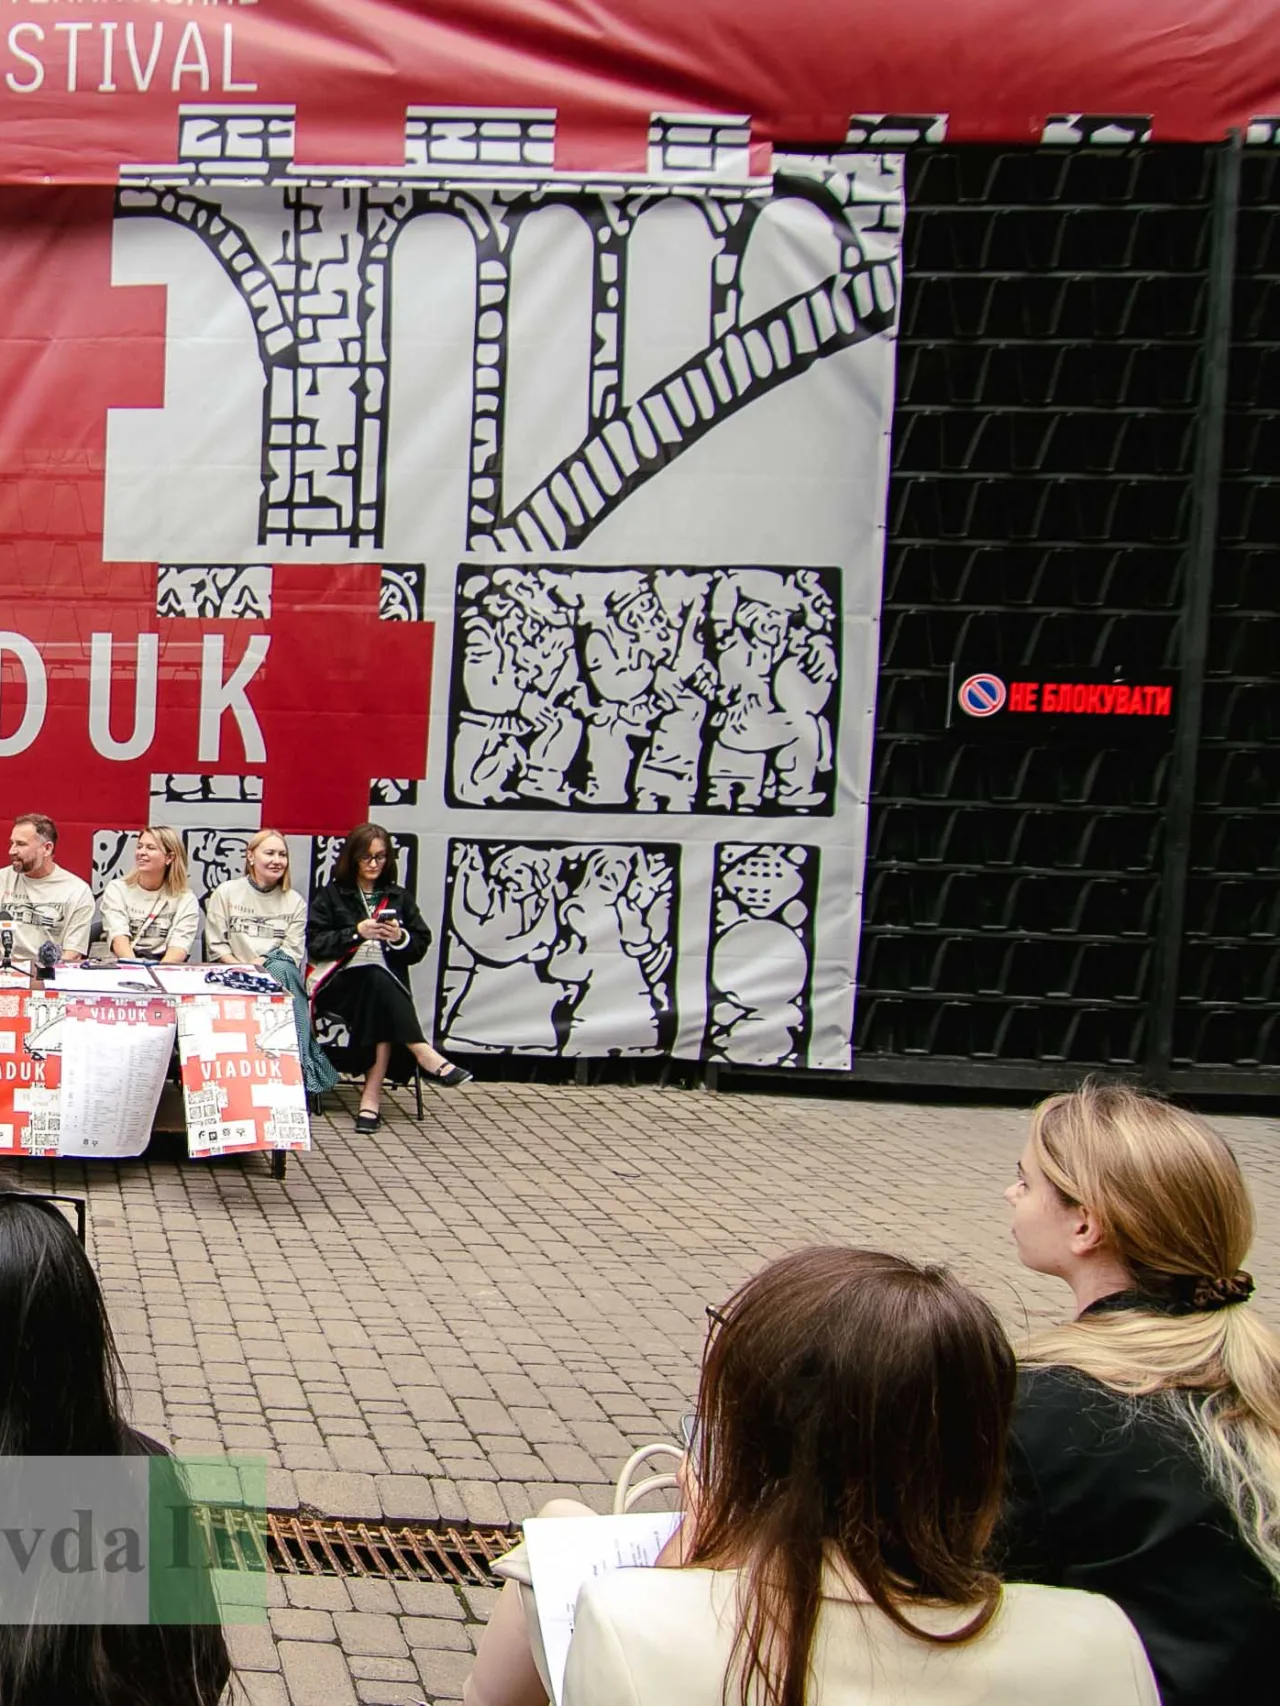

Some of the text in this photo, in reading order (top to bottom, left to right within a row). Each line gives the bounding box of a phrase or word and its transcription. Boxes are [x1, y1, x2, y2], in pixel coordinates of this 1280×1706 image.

[1008, 682, 1172, 716] НЕ БЛОКУВАТИ
[90, 1006, 148, 1022] VIADUK
[200, 1059, 283, 1080] VIADUK
